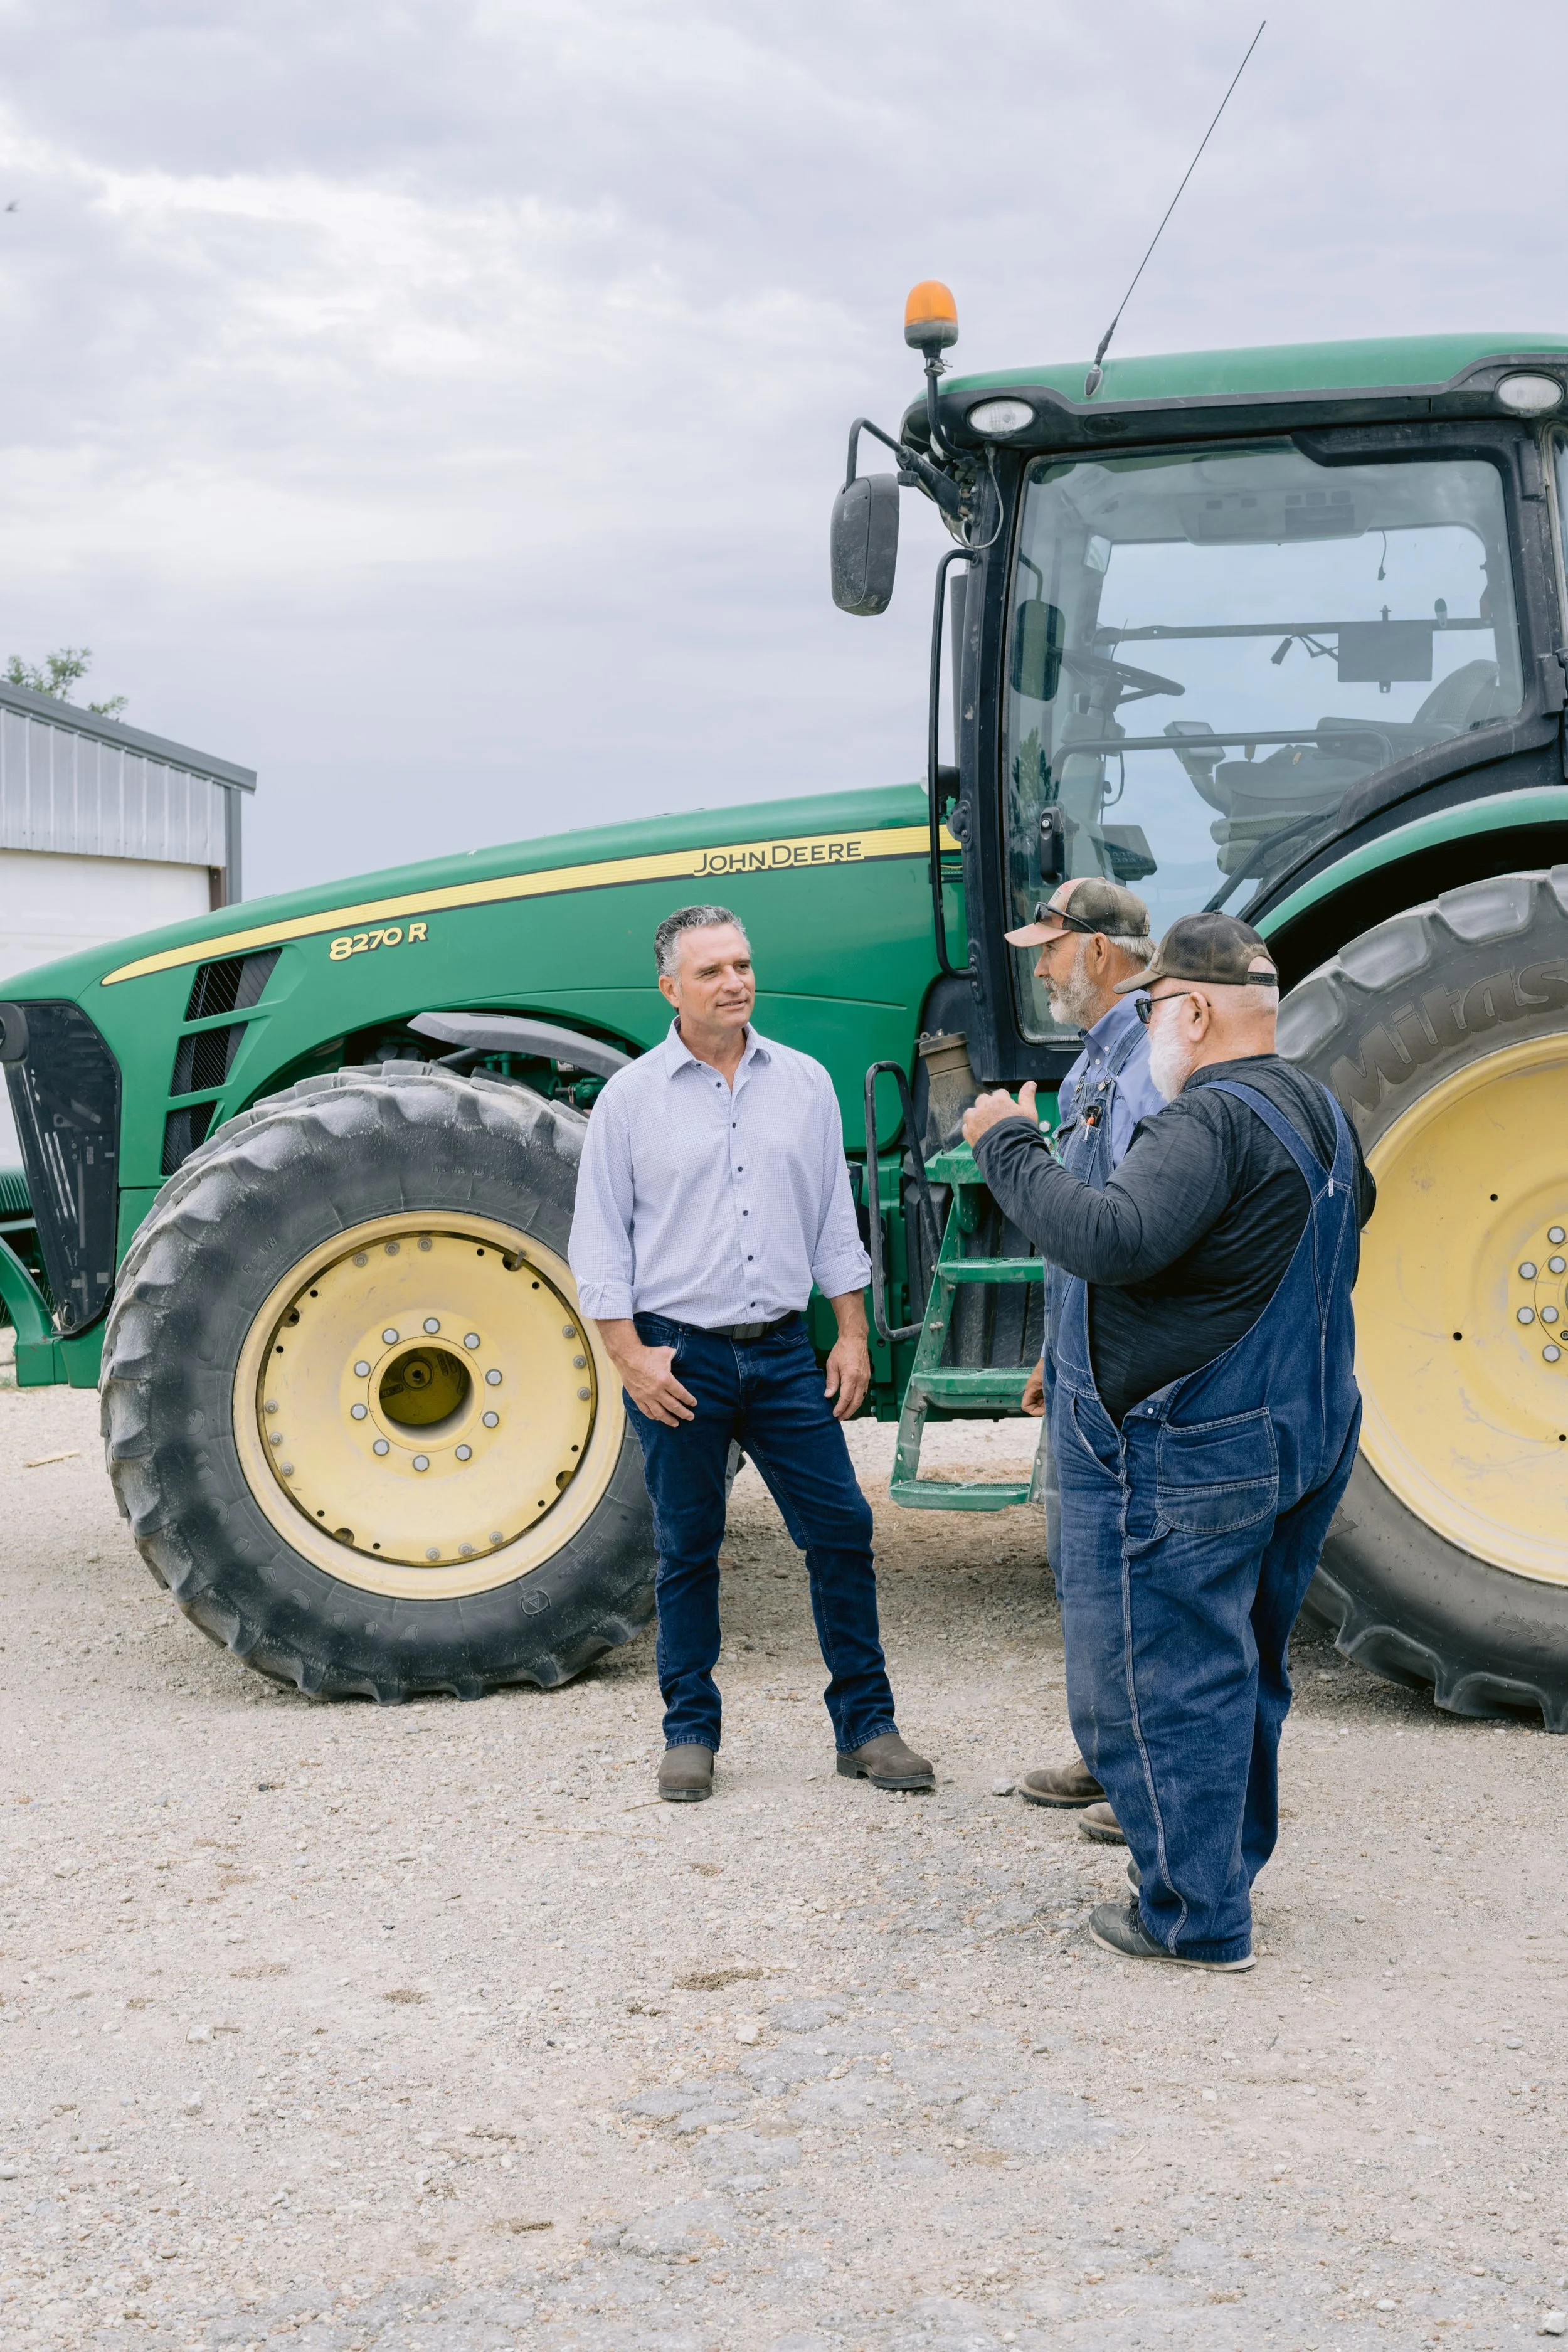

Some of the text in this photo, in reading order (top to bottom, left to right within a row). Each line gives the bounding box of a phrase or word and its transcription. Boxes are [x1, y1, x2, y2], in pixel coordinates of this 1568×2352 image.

[694, 841, 862, 874] JOHN DEERE
[329, 922, 429, 961] 8270 R
